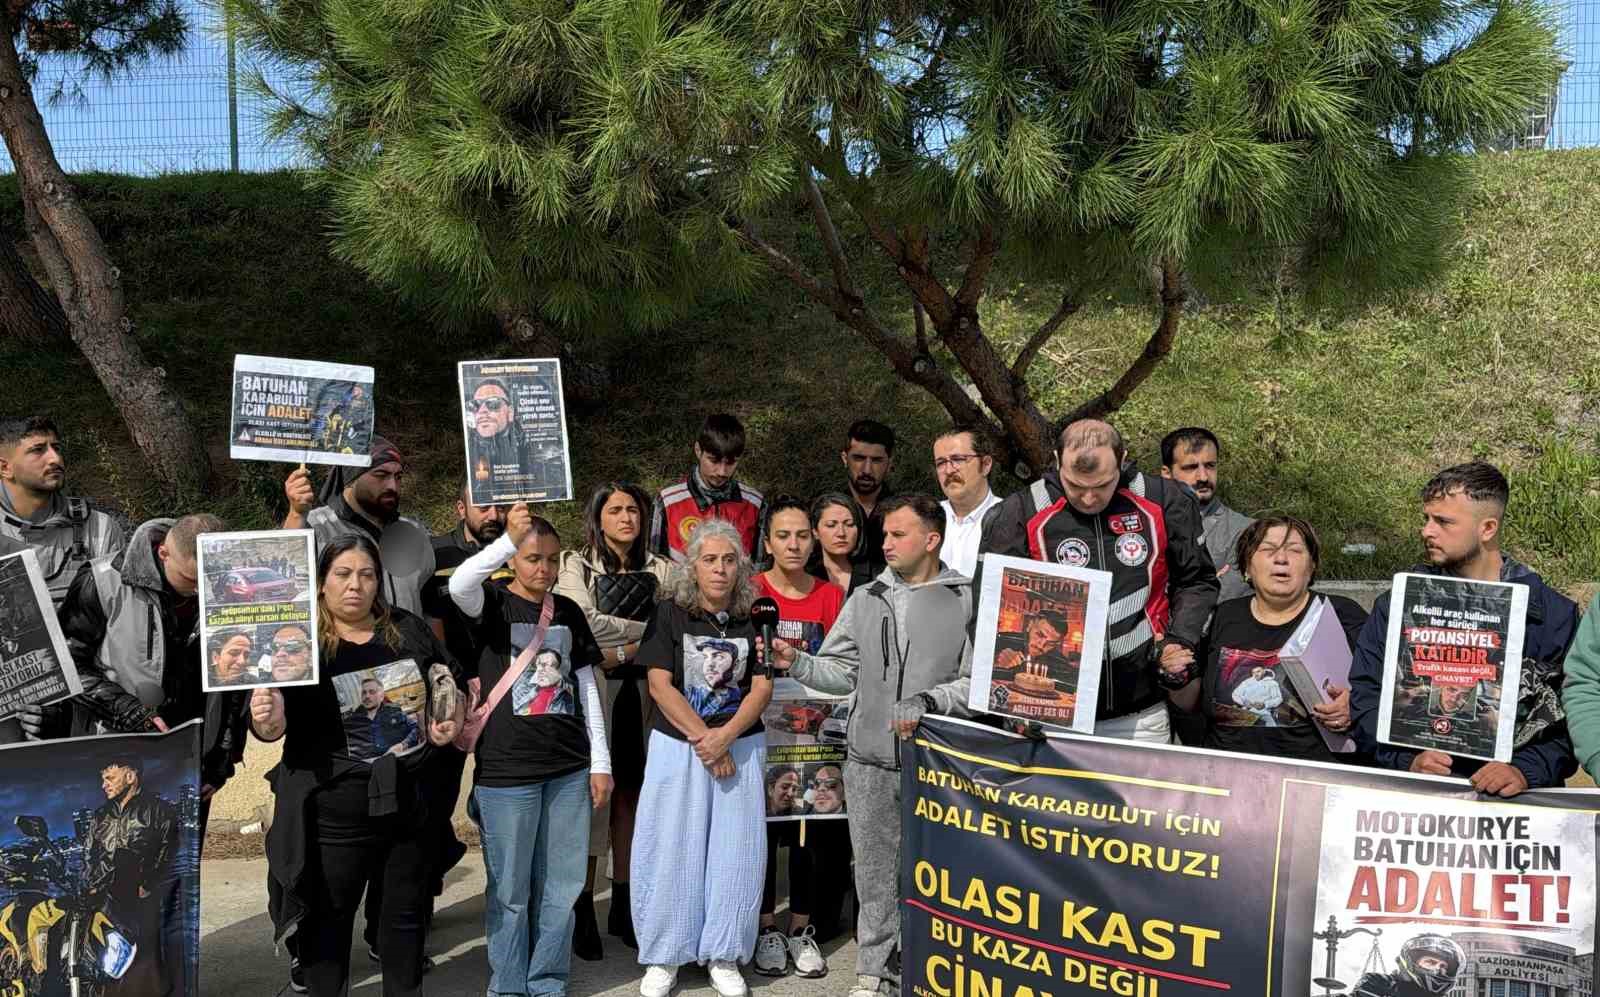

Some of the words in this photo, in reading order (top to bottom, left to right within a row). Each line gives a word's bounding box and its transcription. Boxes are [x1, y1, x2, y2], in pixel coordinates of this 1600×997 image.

[242, 376, 308, 395] BATUHAN
[242, 391, 308, 407] KARABULUT
[241, 403, 266, 417] İÇİN
[267, 405, 312, 420] ADALET
[1008, 574, 1084, 598] BATUHAN
[1412, 605, 1443, 616] Alkollü
[1443, 609, 1463, 620] araç
[1464, 610, 1501, 624] kullanan
[1431, 617, 1446, 627] her
[1448, 620, 1478, 631] sürücü
[776, 620, 803, 631] TUHAN
[1411, 628, 1495, 648] POTANSİYEL
[14, 652, 40, 670] KAST
[918, 766, 1001, 803] BATUHAN
[1008, 790, 1157, 827] KARABULUT
[1165, 808, 1221, 837] İÇİN
[1355, 810, 1530, 840] MOTOKURYE
[914, 797, 1012, 839] ADALET
[1020, 819, 1221, 879] İSTİYORUZ!
[1353, 836, 1498, 870] BATUHAN
[1505, 842, 1562, 874] İÇİN
[1346, 866, 1572, 924] ADALET!
[914, 860, 1041, 930] OLASI
[1062, 901, 1221, 968] KAST
[932, 918, 963, 948] BU
[972, 933, 1053, 977] KAZA
[1064, 958, 1159, 997] DEĞİL
[1478, 956, 1564, 976] GAZİOSMANPAŞA
[926, 954, 1056, 997] CİN
[1494, 968, 1550, 983] ADLİYESİ
